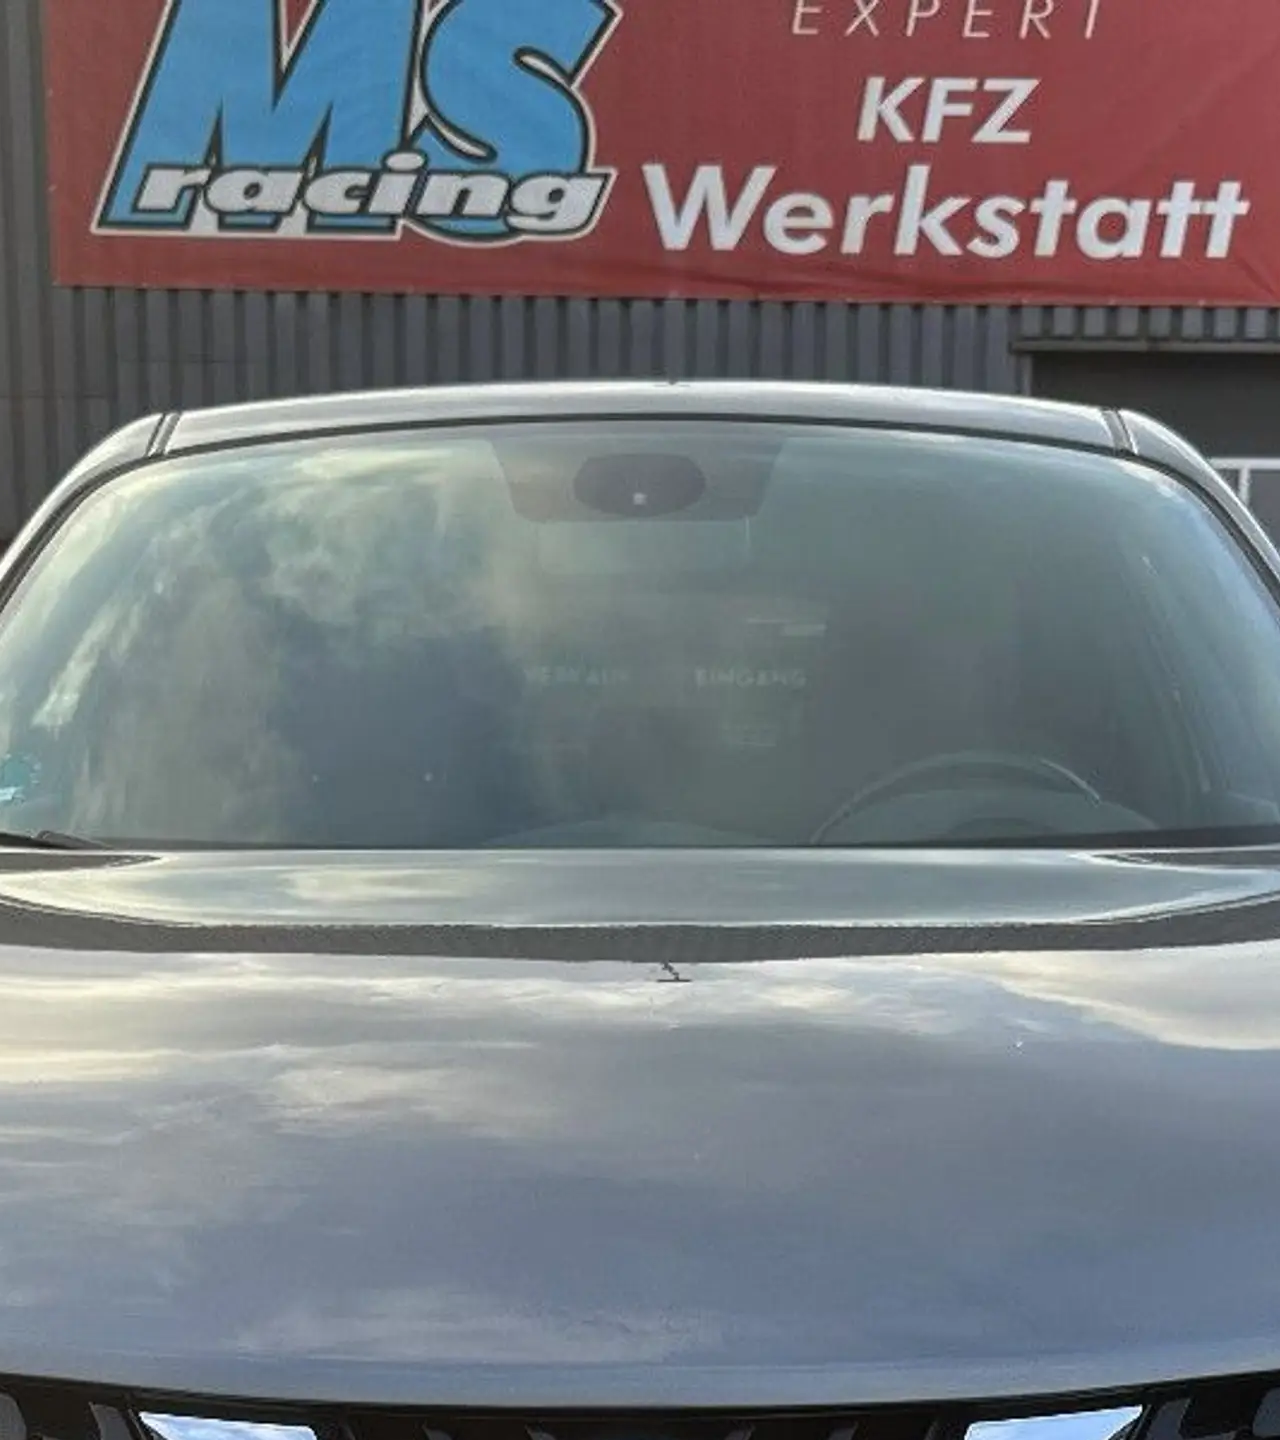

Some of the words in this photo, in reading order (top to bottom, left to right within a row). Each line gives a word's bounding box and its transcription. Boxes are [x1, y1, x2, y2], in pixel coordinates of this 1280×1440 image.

[92, 0, 623, 242] MS
[857, 76, 1040, 143] KFZ
[134, 152, 611, 232] racing
[642, 164, 1250, 259] Werkstatt
